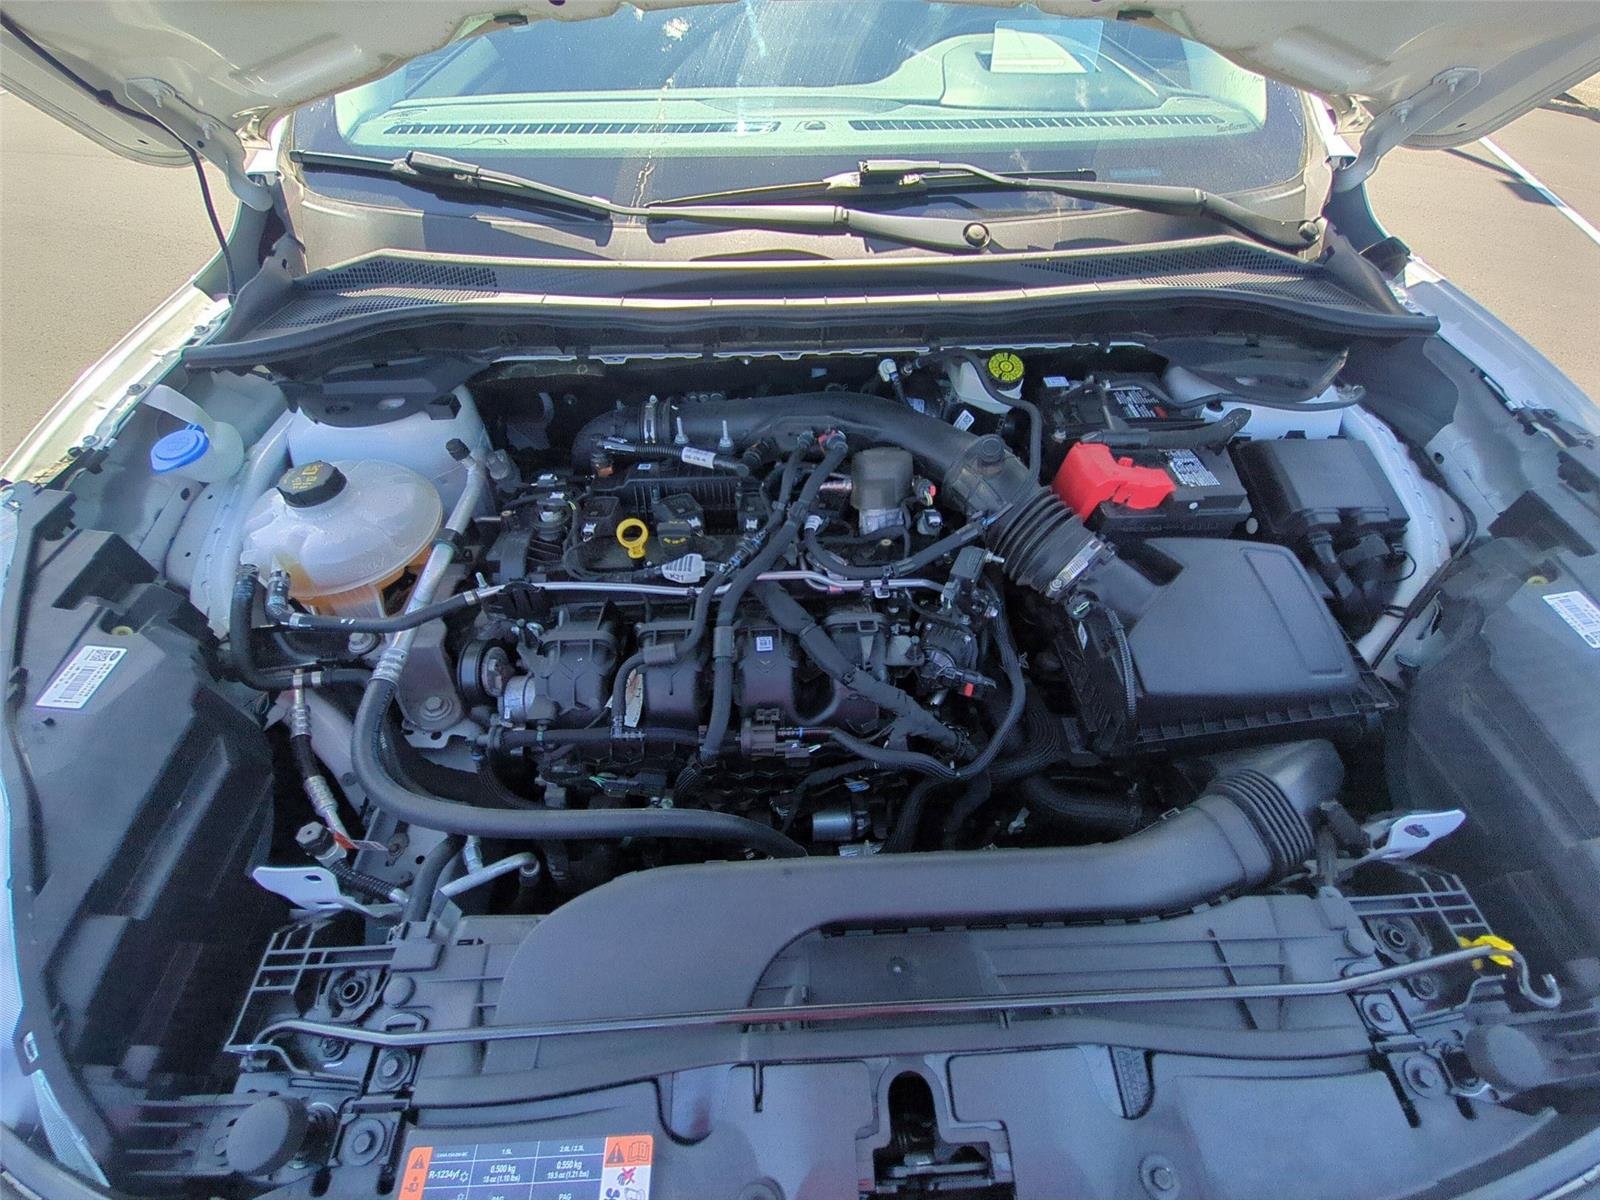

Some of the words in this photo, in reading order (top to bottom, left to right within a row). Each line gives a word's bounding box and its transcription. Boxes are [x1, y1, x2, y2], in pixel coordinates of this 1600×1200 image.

[507, 1165, 516, 1174] kg
[574, 1160, 583, 1170] kg
[429, 1170, 461, 1180] R-1234yf
